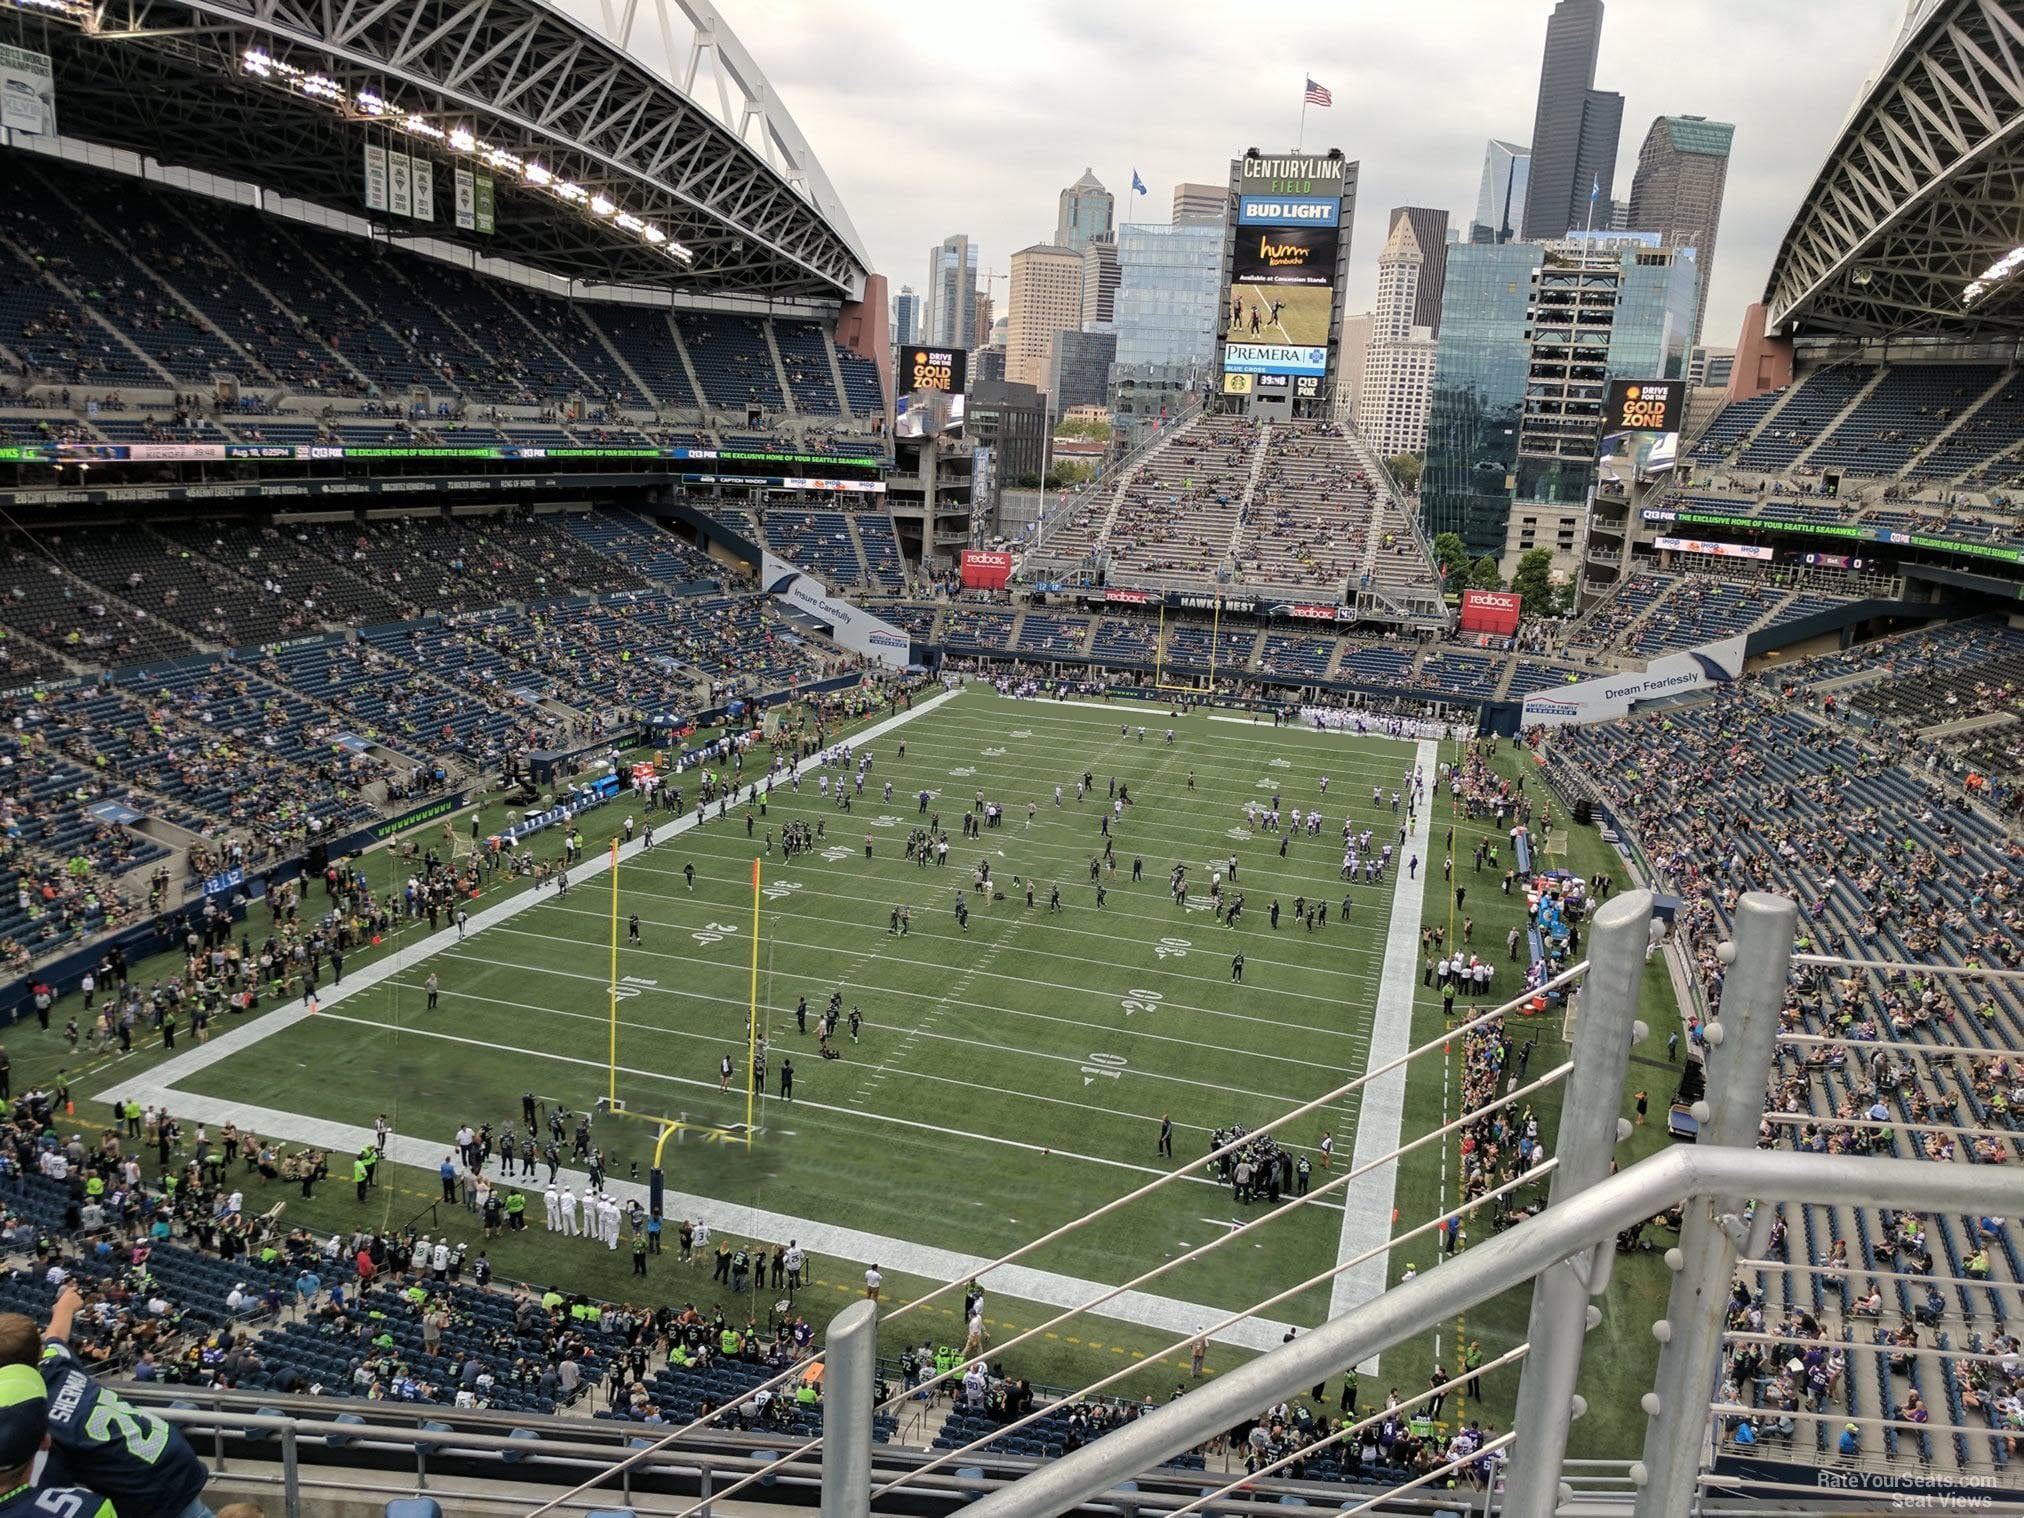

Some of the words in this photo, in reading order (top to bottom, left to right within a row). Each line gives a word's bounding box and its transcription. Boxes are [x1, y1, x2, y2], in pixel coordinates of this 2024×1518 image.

[1244, 157, 1343, 179] CENTURYLINK
[1271, 180, 1312, 194] FIELD
[1246, 204, 1281, 218] BUD
[1282, 204, 1332, 219] LIGHT
[929, 352, 952, 361] DRIVE
[1226, 345, 1300, 362] PREMERA
[913, 366, 952, 378] GOLD
[913, 377, 951, 390] ZONE
[1297, 377, 1318, 387] Q13
[1297, 387, 1316, 397] FOX
[1642, 386, 1669, 395] DRIVE
[1623, 400, 1666, 415] GOLD
[1621, 414, 1665, 428] ZONE
[688, 450, 703, 458] Q13
[703, 450, 717, 459] FOX
[719, 451, 731, 459] THE
[732, 452, 765, 460] EXCLUSIVE
[766, 453, 783, 461] HOME
[794, 454, 811, 462] YOUR
[812, 455, 837, 464] SEATTLE
[1643, 510, 1659, 519] Q13
[1660, 512, 1675, 521] FOX
[1678, 513, 1692, 522] THE
[1693, 514, 1729, 525] EXCLUSIVE
[1731, 518, 1751, 527] HOME
[1752, 520, 1762, 528] OF
[1763, 521, 1783, 529] YOUR
[1784, 522, 1814, 533] SEATTLE
[1815, 526, 1857, 537] SEAHAWKS
[1806, 554, 1814, 563] 0
[1853, 558, 1862, 568] 0
[794, 588, 818, 606] Insure
[819, 601, 852, 624] Carefully
[1181, 597, 1222, 610] HAWKS
[1225, 600, 1256, 612] NEST
[1605, 685, 1640, 699] Dream
[1643, 672, 1698, 691] Fearlessly
[207, 879, 220, 893] 12
[227, 871, 241, 885] 12
[762, 880, 802, 897] 30
[691, 922, 738, 942] 20
[1154, 937, 1192, 957] 30
[606, 975, 658, 997] 10
[1121, 988, 1163, 1013] 20
[1081, 1053, 1128, 1079] 10
